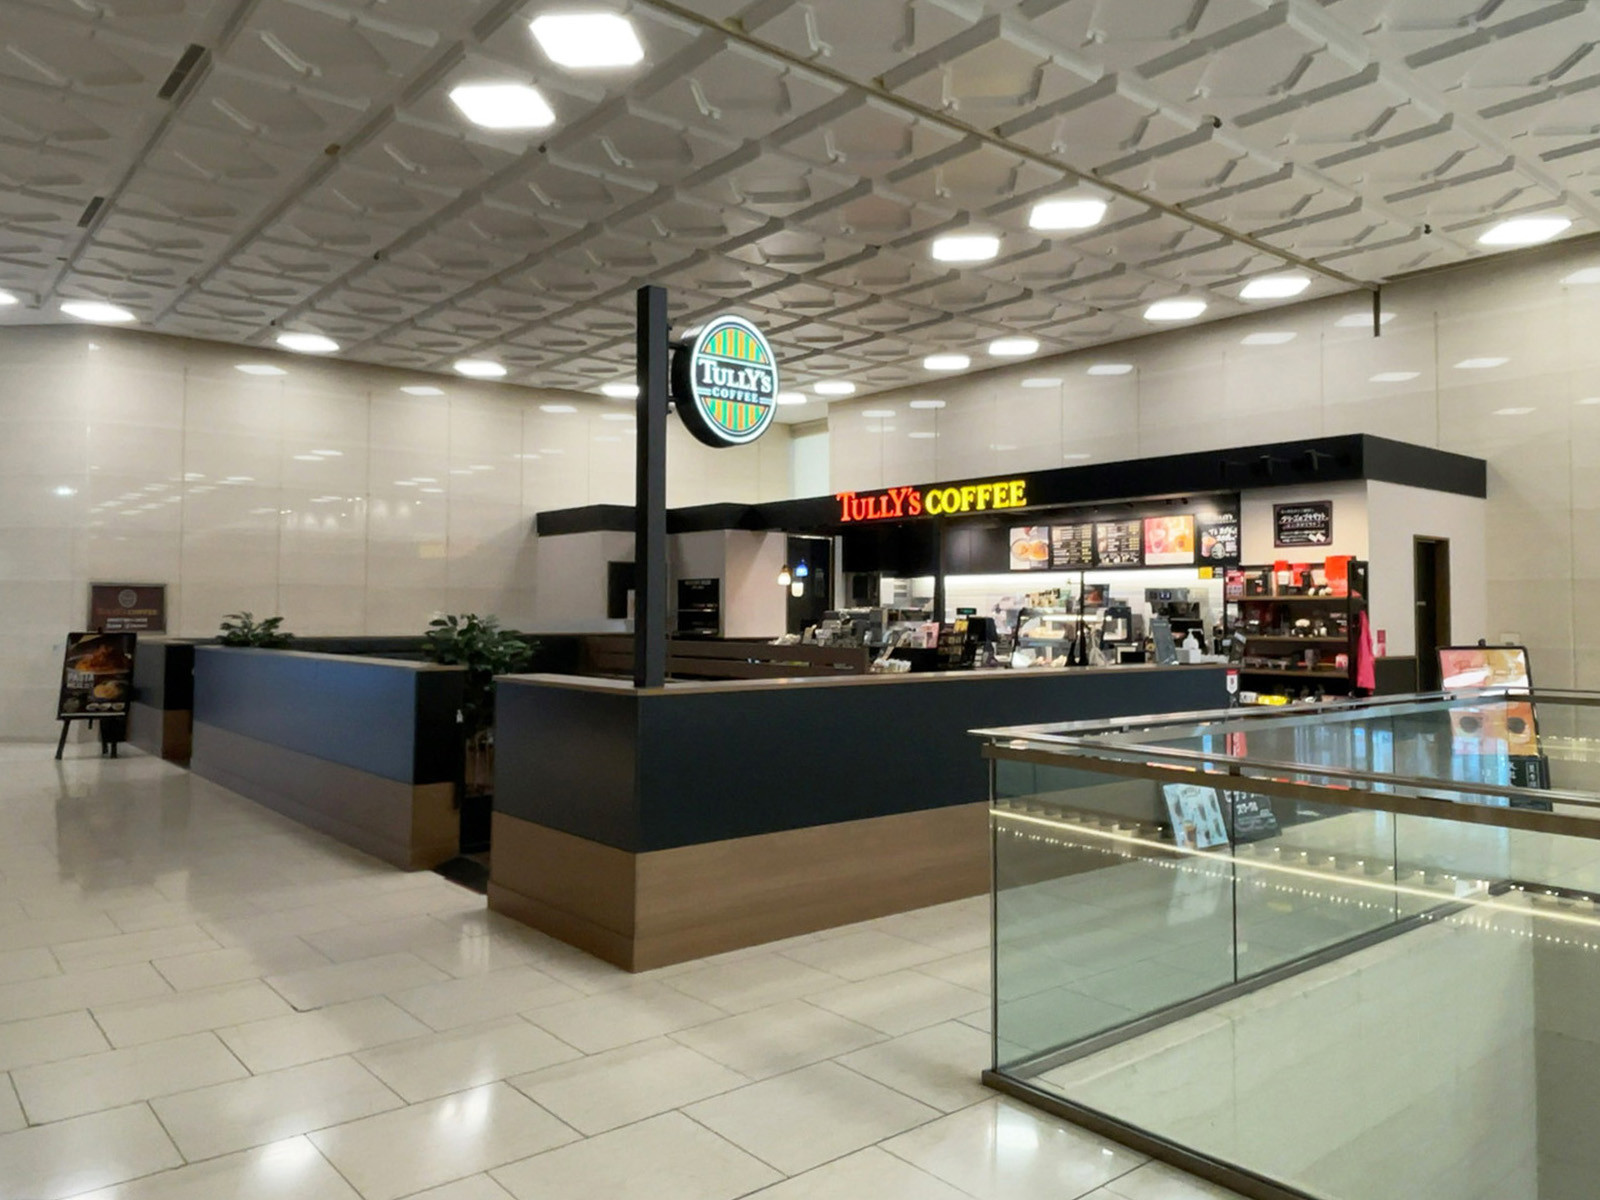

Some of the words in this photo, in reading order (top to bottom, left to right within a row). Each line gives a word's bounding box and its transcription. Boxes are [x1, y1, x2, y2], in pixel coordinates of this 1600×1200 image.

[699, 360, 772, 393] TULLY'S
[711, 386, 760, 402] COFFEE
[836, 487, 921, 521] TULLY'S
[926, 480, 1026, 515] COFFEE
